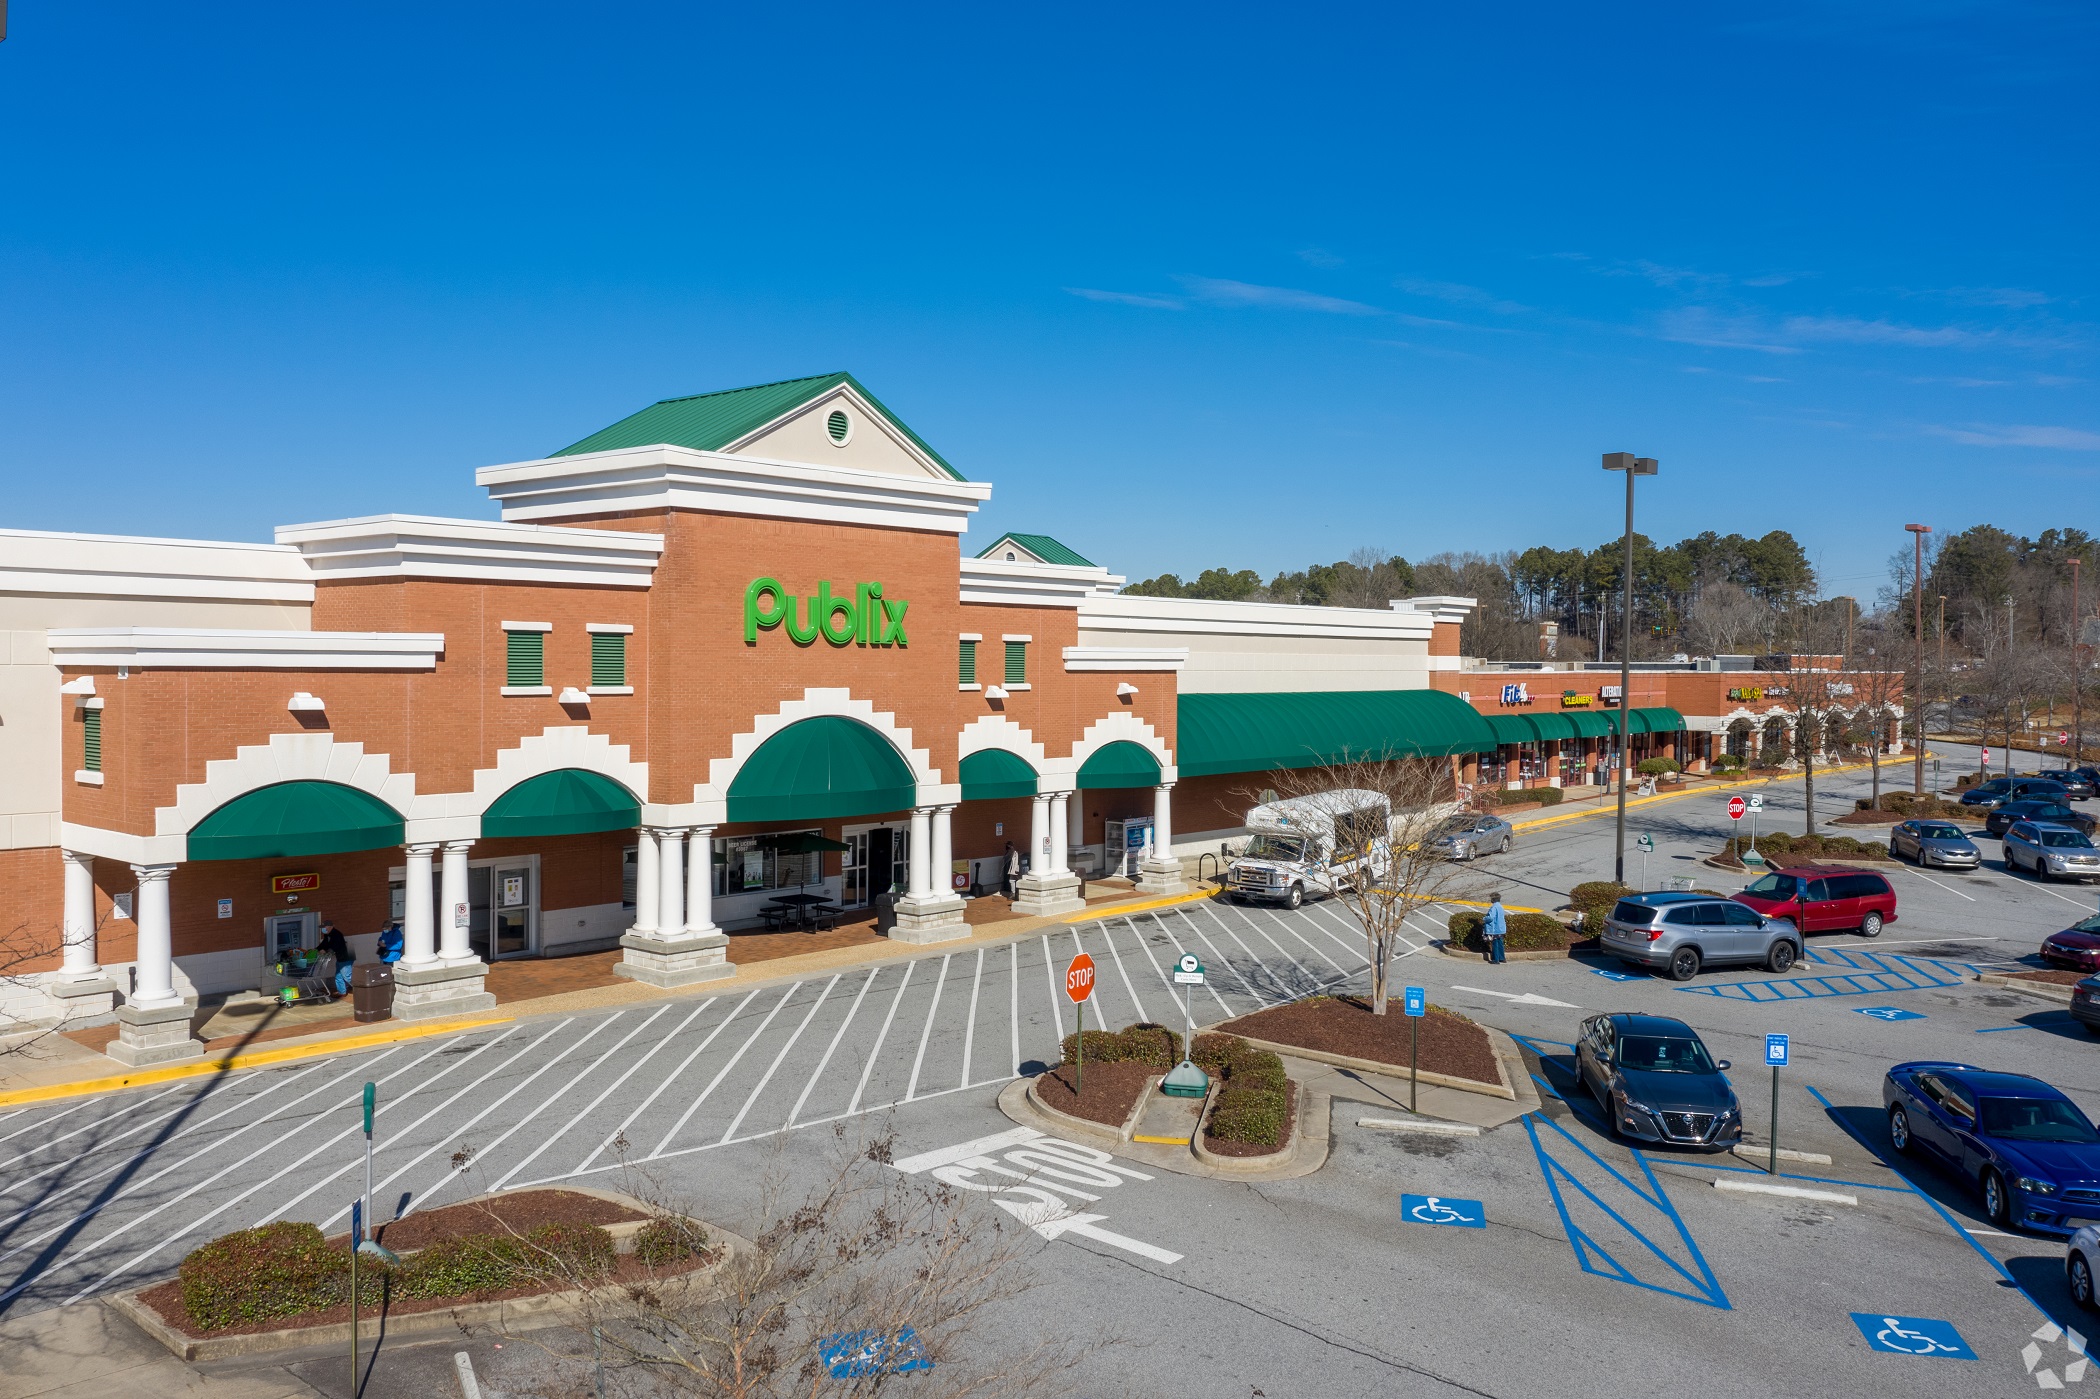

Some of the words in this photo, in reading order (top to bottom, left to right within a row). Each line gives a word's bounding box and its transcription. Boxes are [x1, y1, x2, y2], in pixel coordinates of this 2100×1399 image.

[744, 577, 909, 646] Publix
[1564, 695, 1593, 705] CLEANERS
[1729, 803, 1744, 813] STOP
[1068, 966, 1094, 990] STOP
[931, 1138, 1155, 1209] STOP
